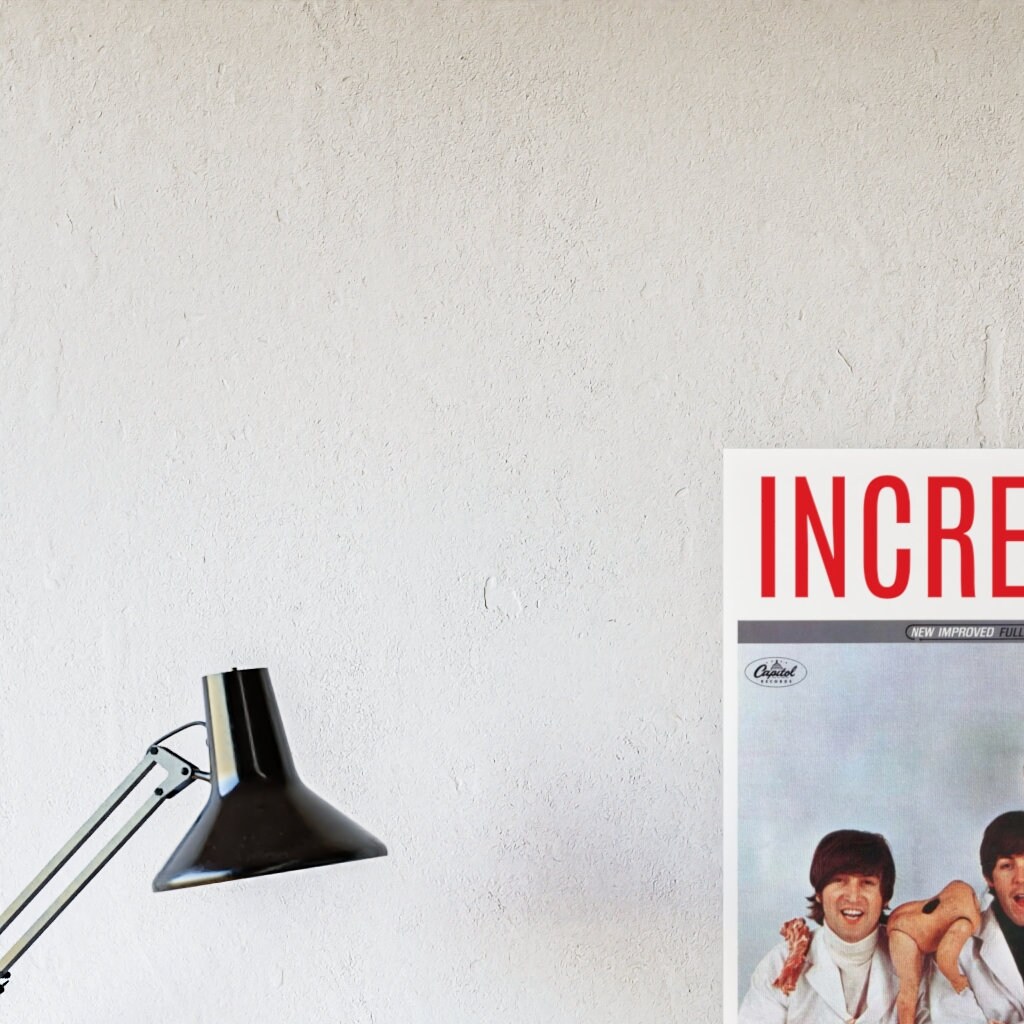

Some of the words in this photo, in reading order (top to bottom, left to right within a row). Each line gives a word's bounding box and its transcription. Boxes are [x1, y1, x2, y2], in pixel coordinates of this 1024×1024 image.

[911, 627, 935, 638] NEW
[938, 627, 994, 638] IMPROVED
[1000, 627, 1024, 638] FULL
[753, 664, 798, 679] Capitol
